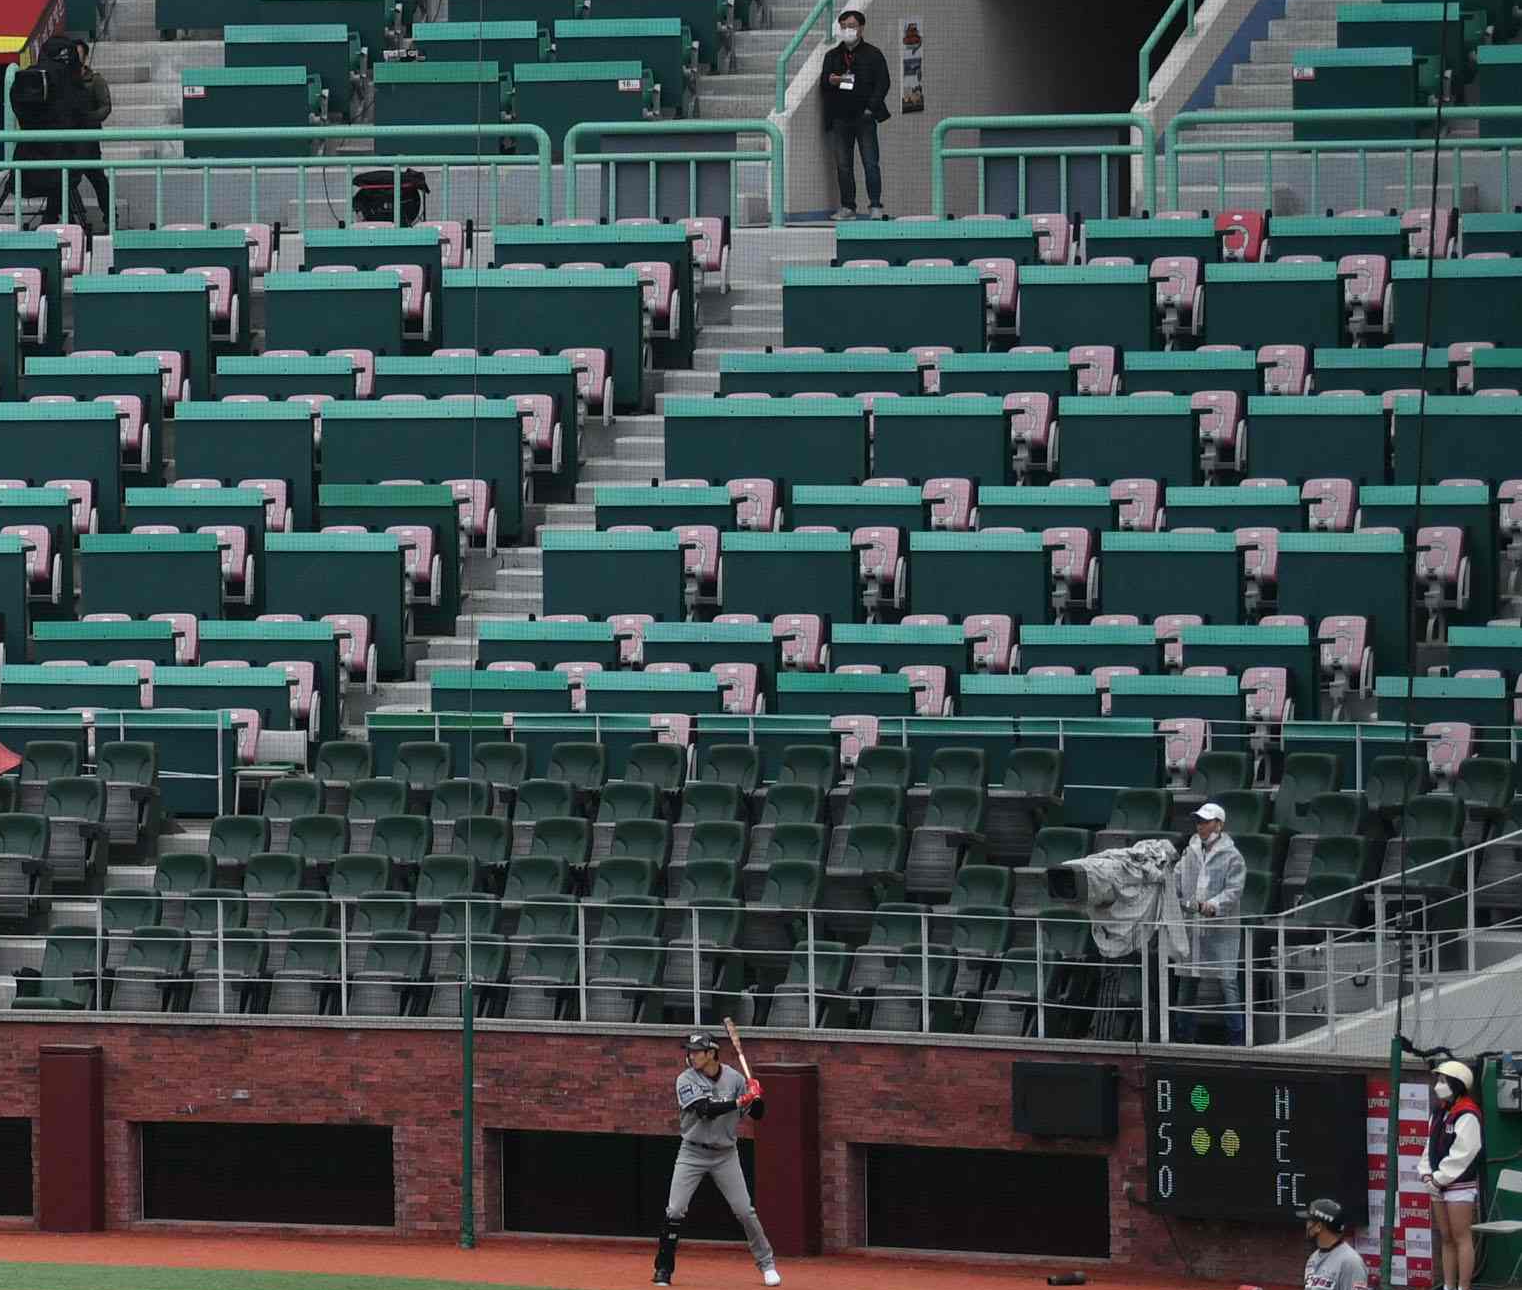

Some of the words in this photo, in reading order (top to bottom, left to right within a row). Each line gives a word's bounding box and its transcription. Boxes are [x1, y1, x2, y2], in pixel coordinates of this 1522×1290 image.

[1157, 1079, 1172, 1113] B
[1275, 1085, 1291, 1120] H
[1159, 1121, 1173, 1156] S
[1276, 1129, 1291, 1163] E
[1276, 1171, 1307, 1207] FC
